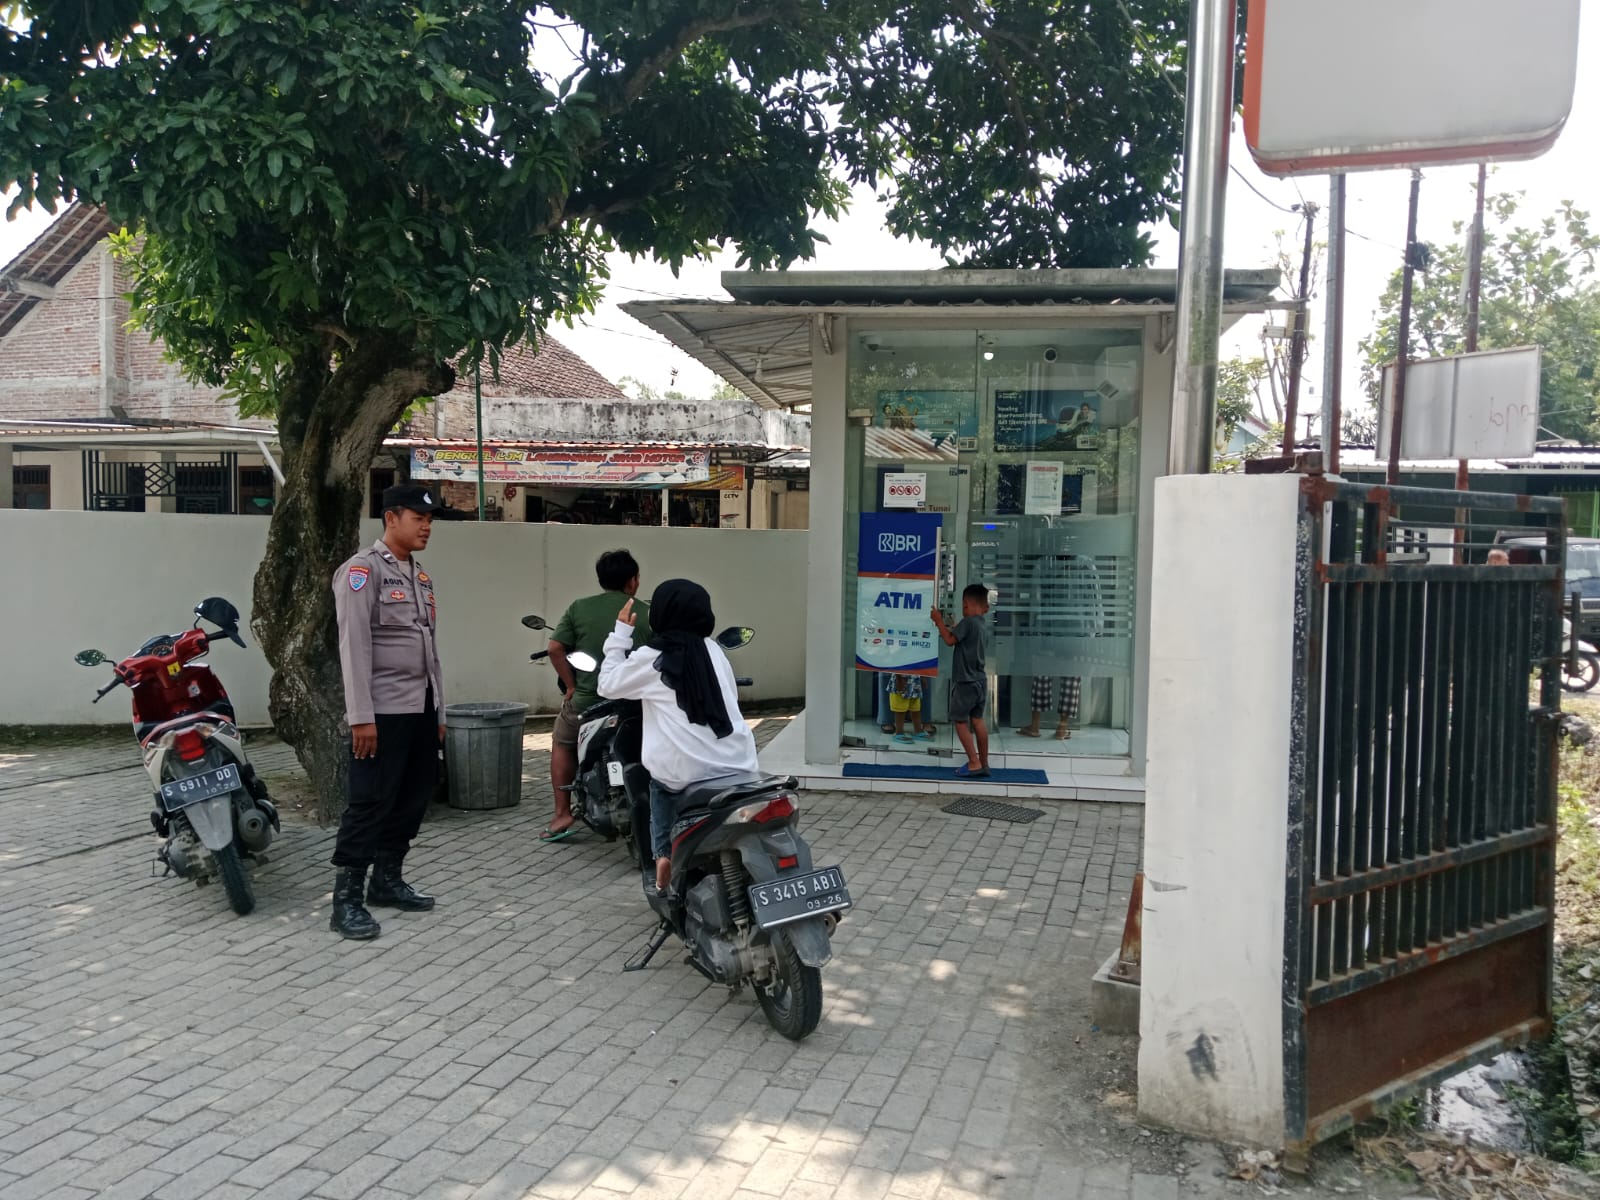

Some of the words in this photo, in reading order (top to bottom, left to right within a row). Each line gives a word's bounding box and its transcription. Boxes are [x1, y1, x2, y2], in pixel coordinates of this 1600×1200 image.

[435, 451, 494, 462] BENGKL
[644, 454, 686, 464] MOTOR
[896, 535, 920, 551] BRI
[874, 592, 922, 610] ATM
[611, 763, 618, 774] S
[164, 786, 173, 797] S
[180, 775, 208, 792] 6911
[759, 891, 769, 905] S
[774, 880, 807, 902] 3415
